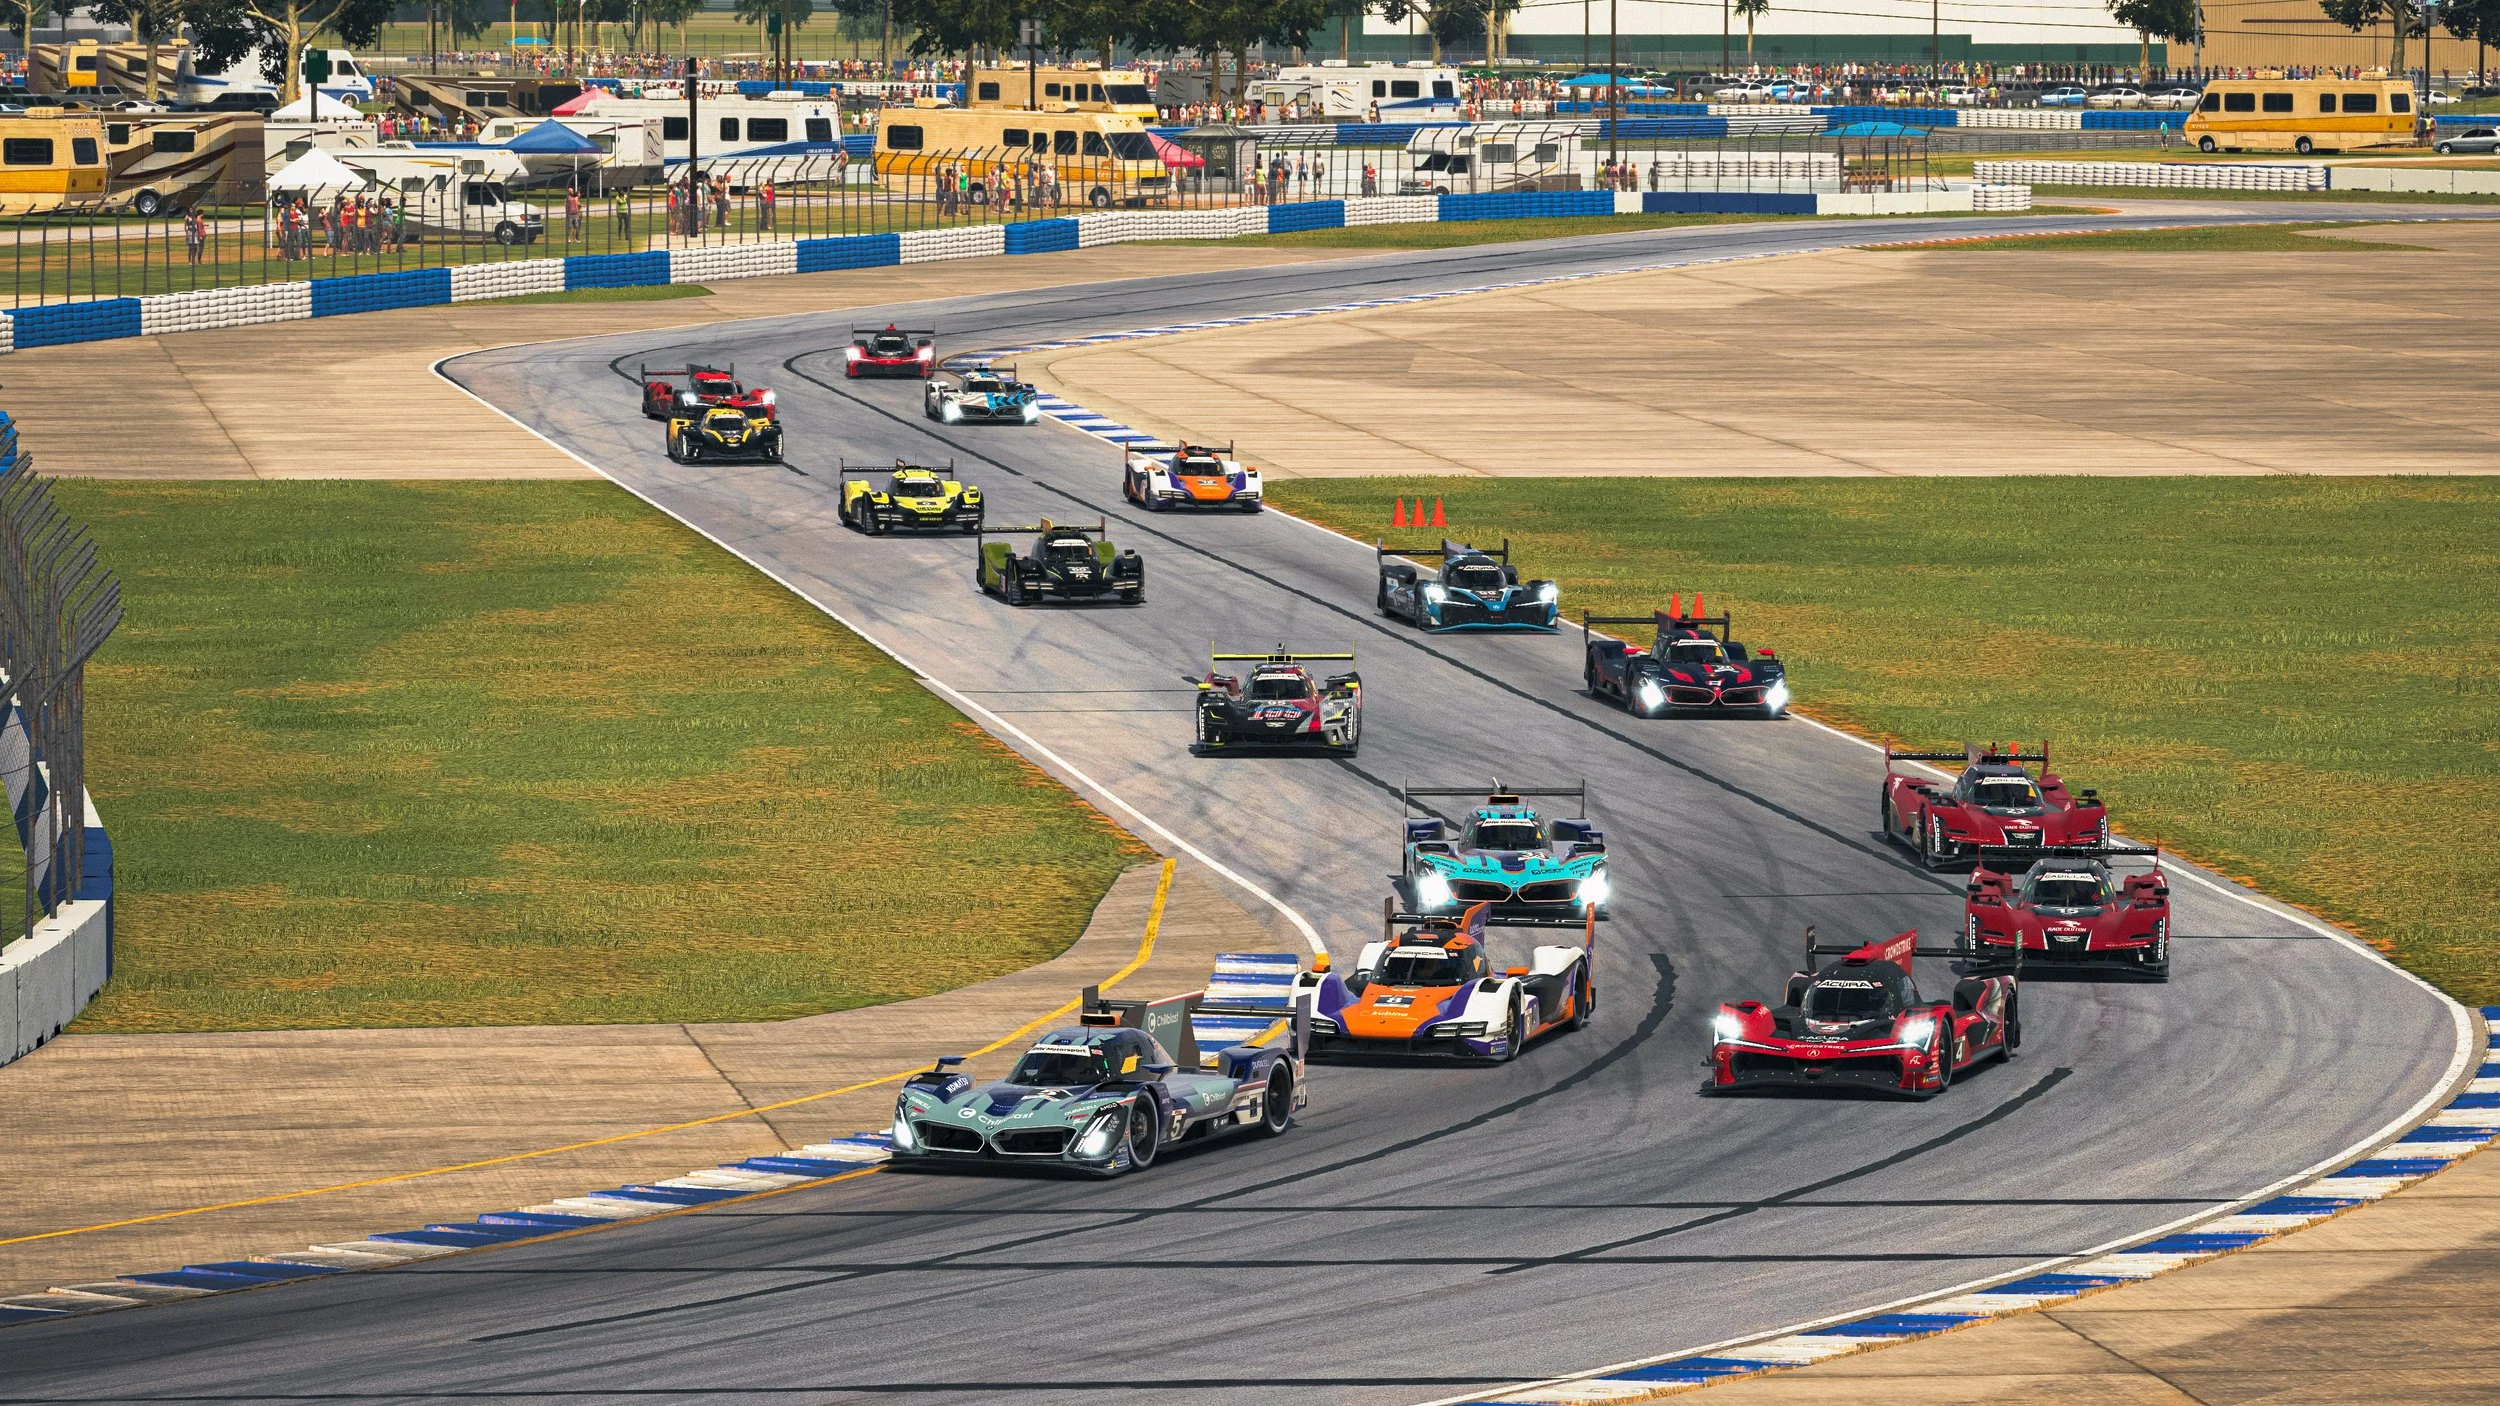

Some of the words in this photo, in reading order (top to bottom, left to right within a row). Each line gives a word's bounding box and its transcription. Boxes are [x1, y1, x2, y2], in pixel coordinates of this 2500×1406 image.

[1157, 1011, 1179, 1027] Chillblast
[1955, 1041, 1963, 1062] 4
[1251, 1059, 1271, 1070] DURACELL
[945, 1077, 970, 1094] KOMATSU
[908, 1096, 932, 1110] DURACELL
[1064, 1104, 1098, 1116] DURACELL
[1170, 1116, 1182, 1138] 5
